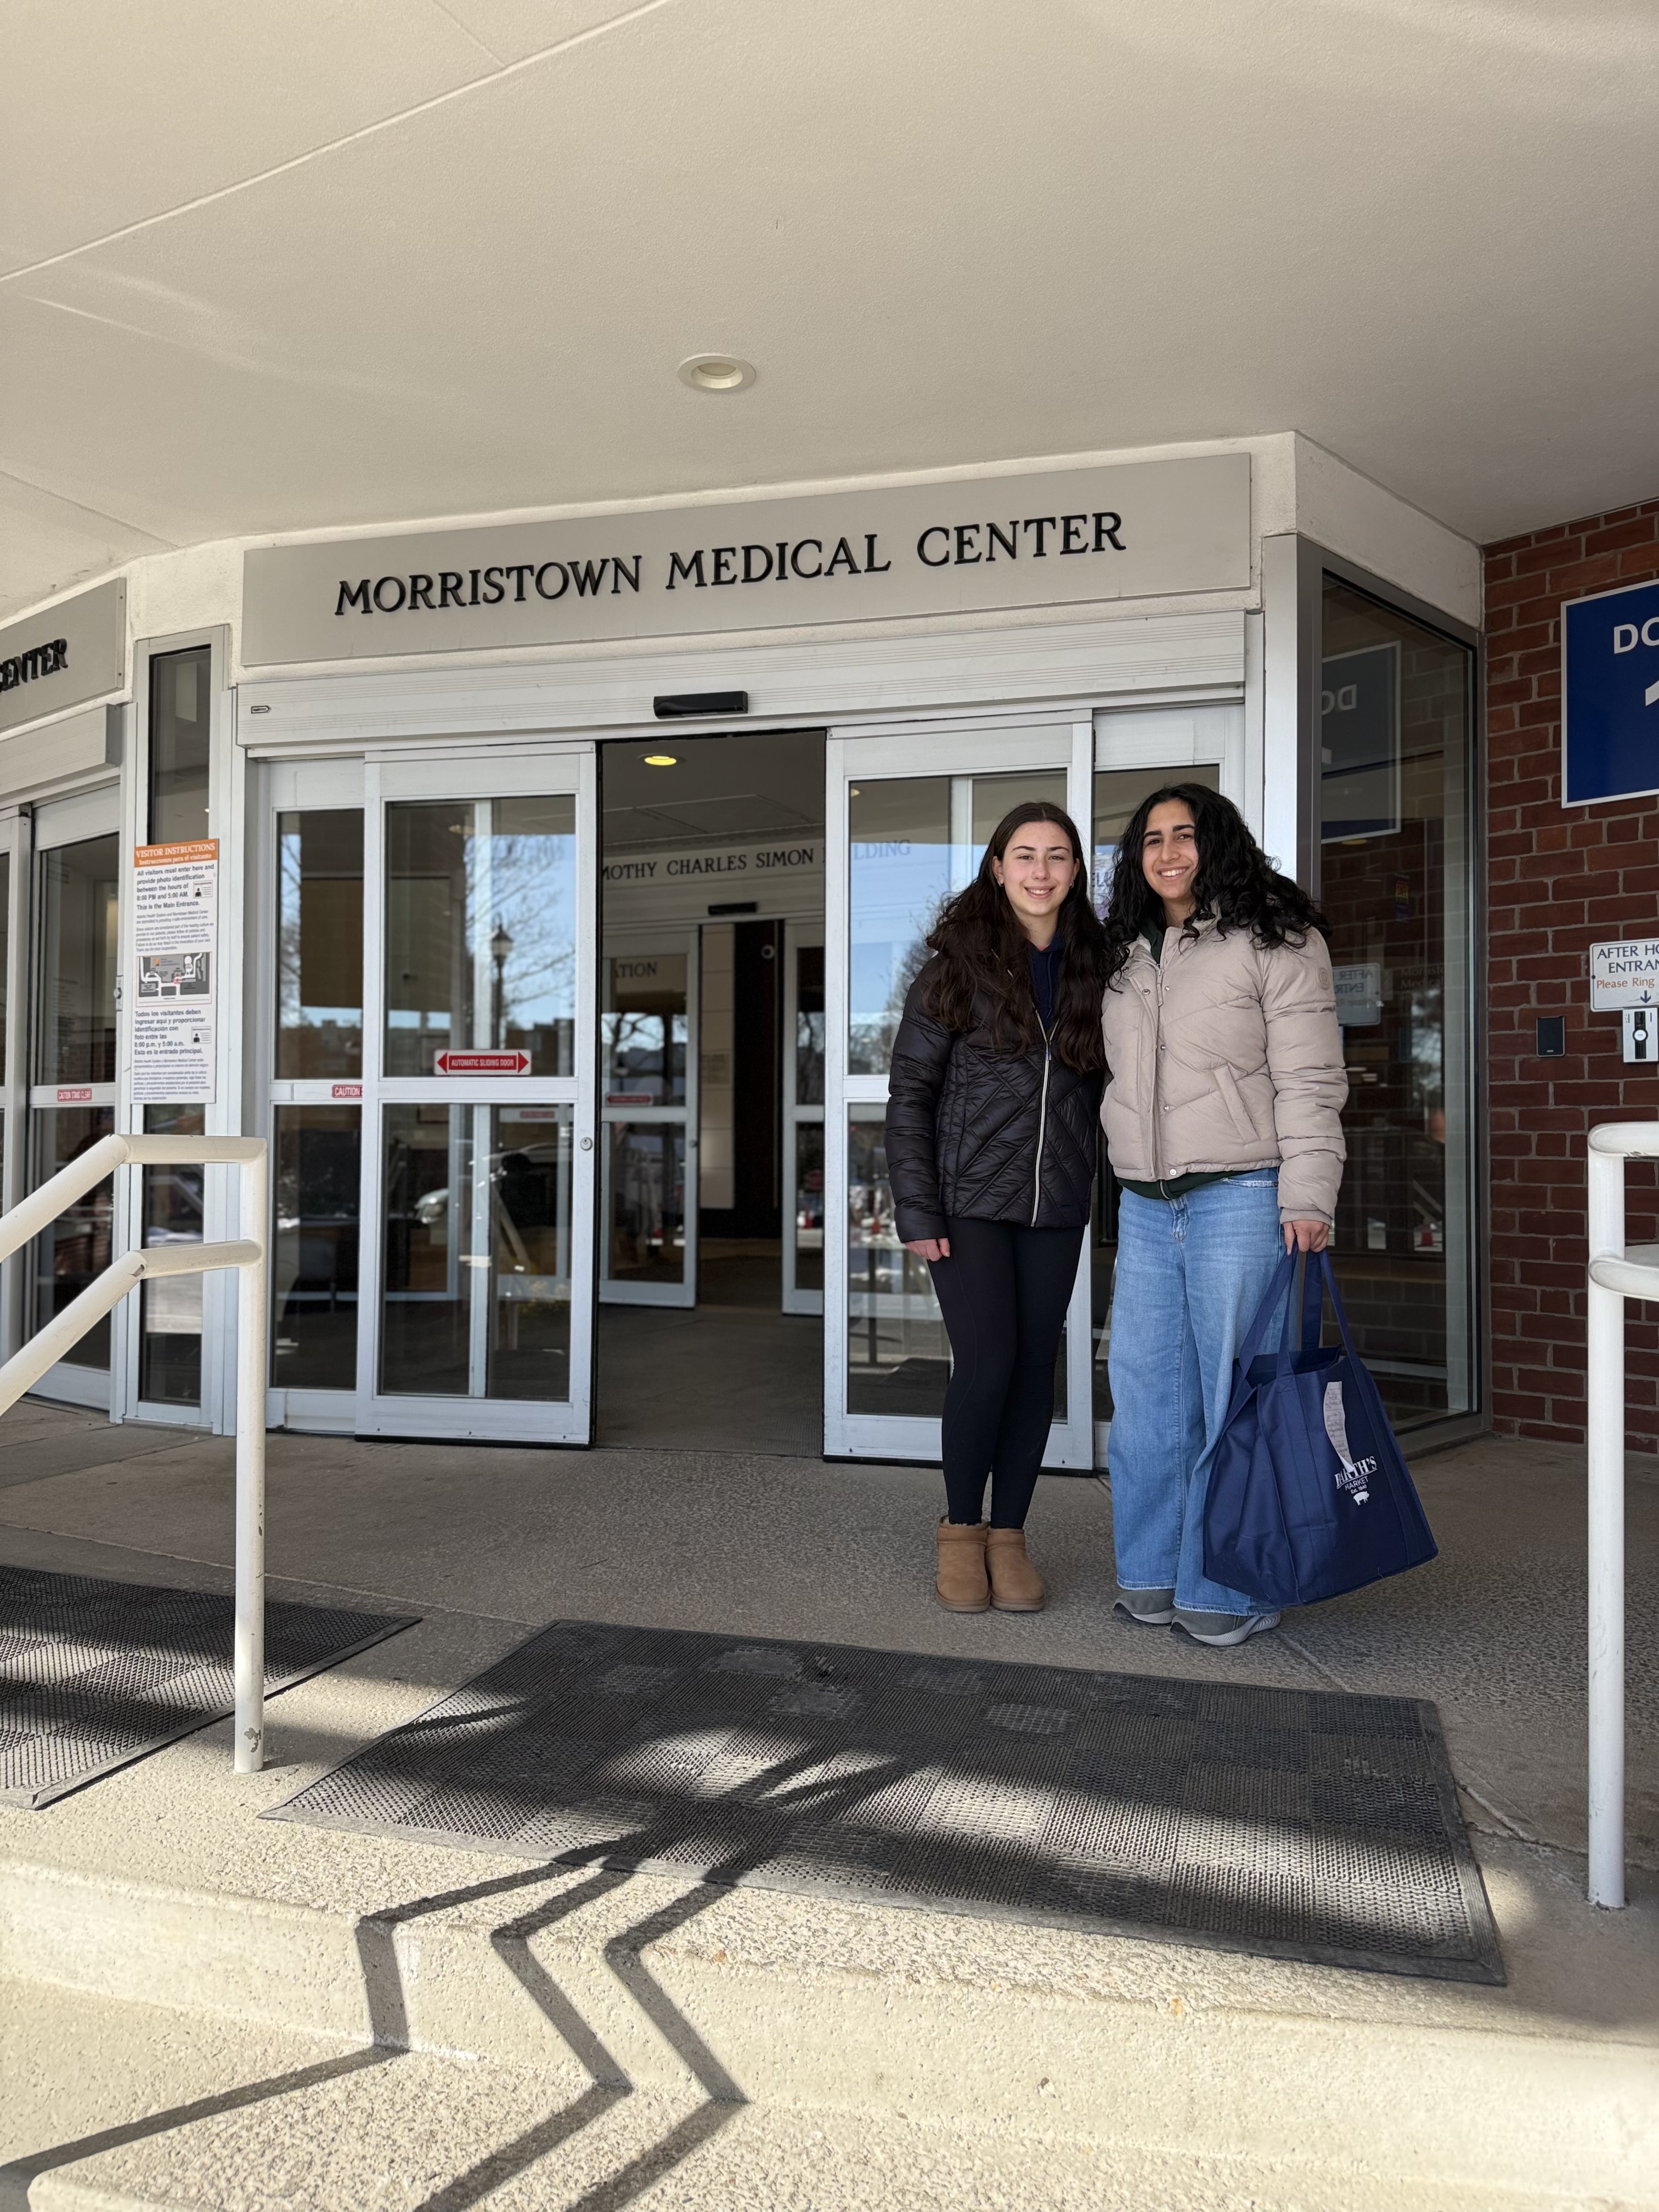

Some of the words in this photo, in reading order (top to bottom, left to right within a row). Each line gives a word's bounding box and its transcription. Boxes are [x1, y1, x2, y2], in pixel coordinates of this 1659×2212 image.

[334, 555, 642, 616] MORRISTOWN
[665, 534, 891, 590] MEDICAL
[917, 512, 1126, 567] CENTER
[0, 639, 69, 693] ENTER
[136, 848, 163, 857] VISITOR
[165, 843, 215, 855] INSTRUCTIONS
[139, 857, 172, 866] Instrucciones
[667, 854, 747, 876] CHARLES
[756, 848, 814, 868] SIMON
[1597, 945, 1639, 960] AFTER
[1597, 979, 1628, 989] Please
[1632, 977, 1655, 989] Ring
[335, 1087, 360, 1096] CAUTION
[1344, 1476, 1369, 1491] MARKET
